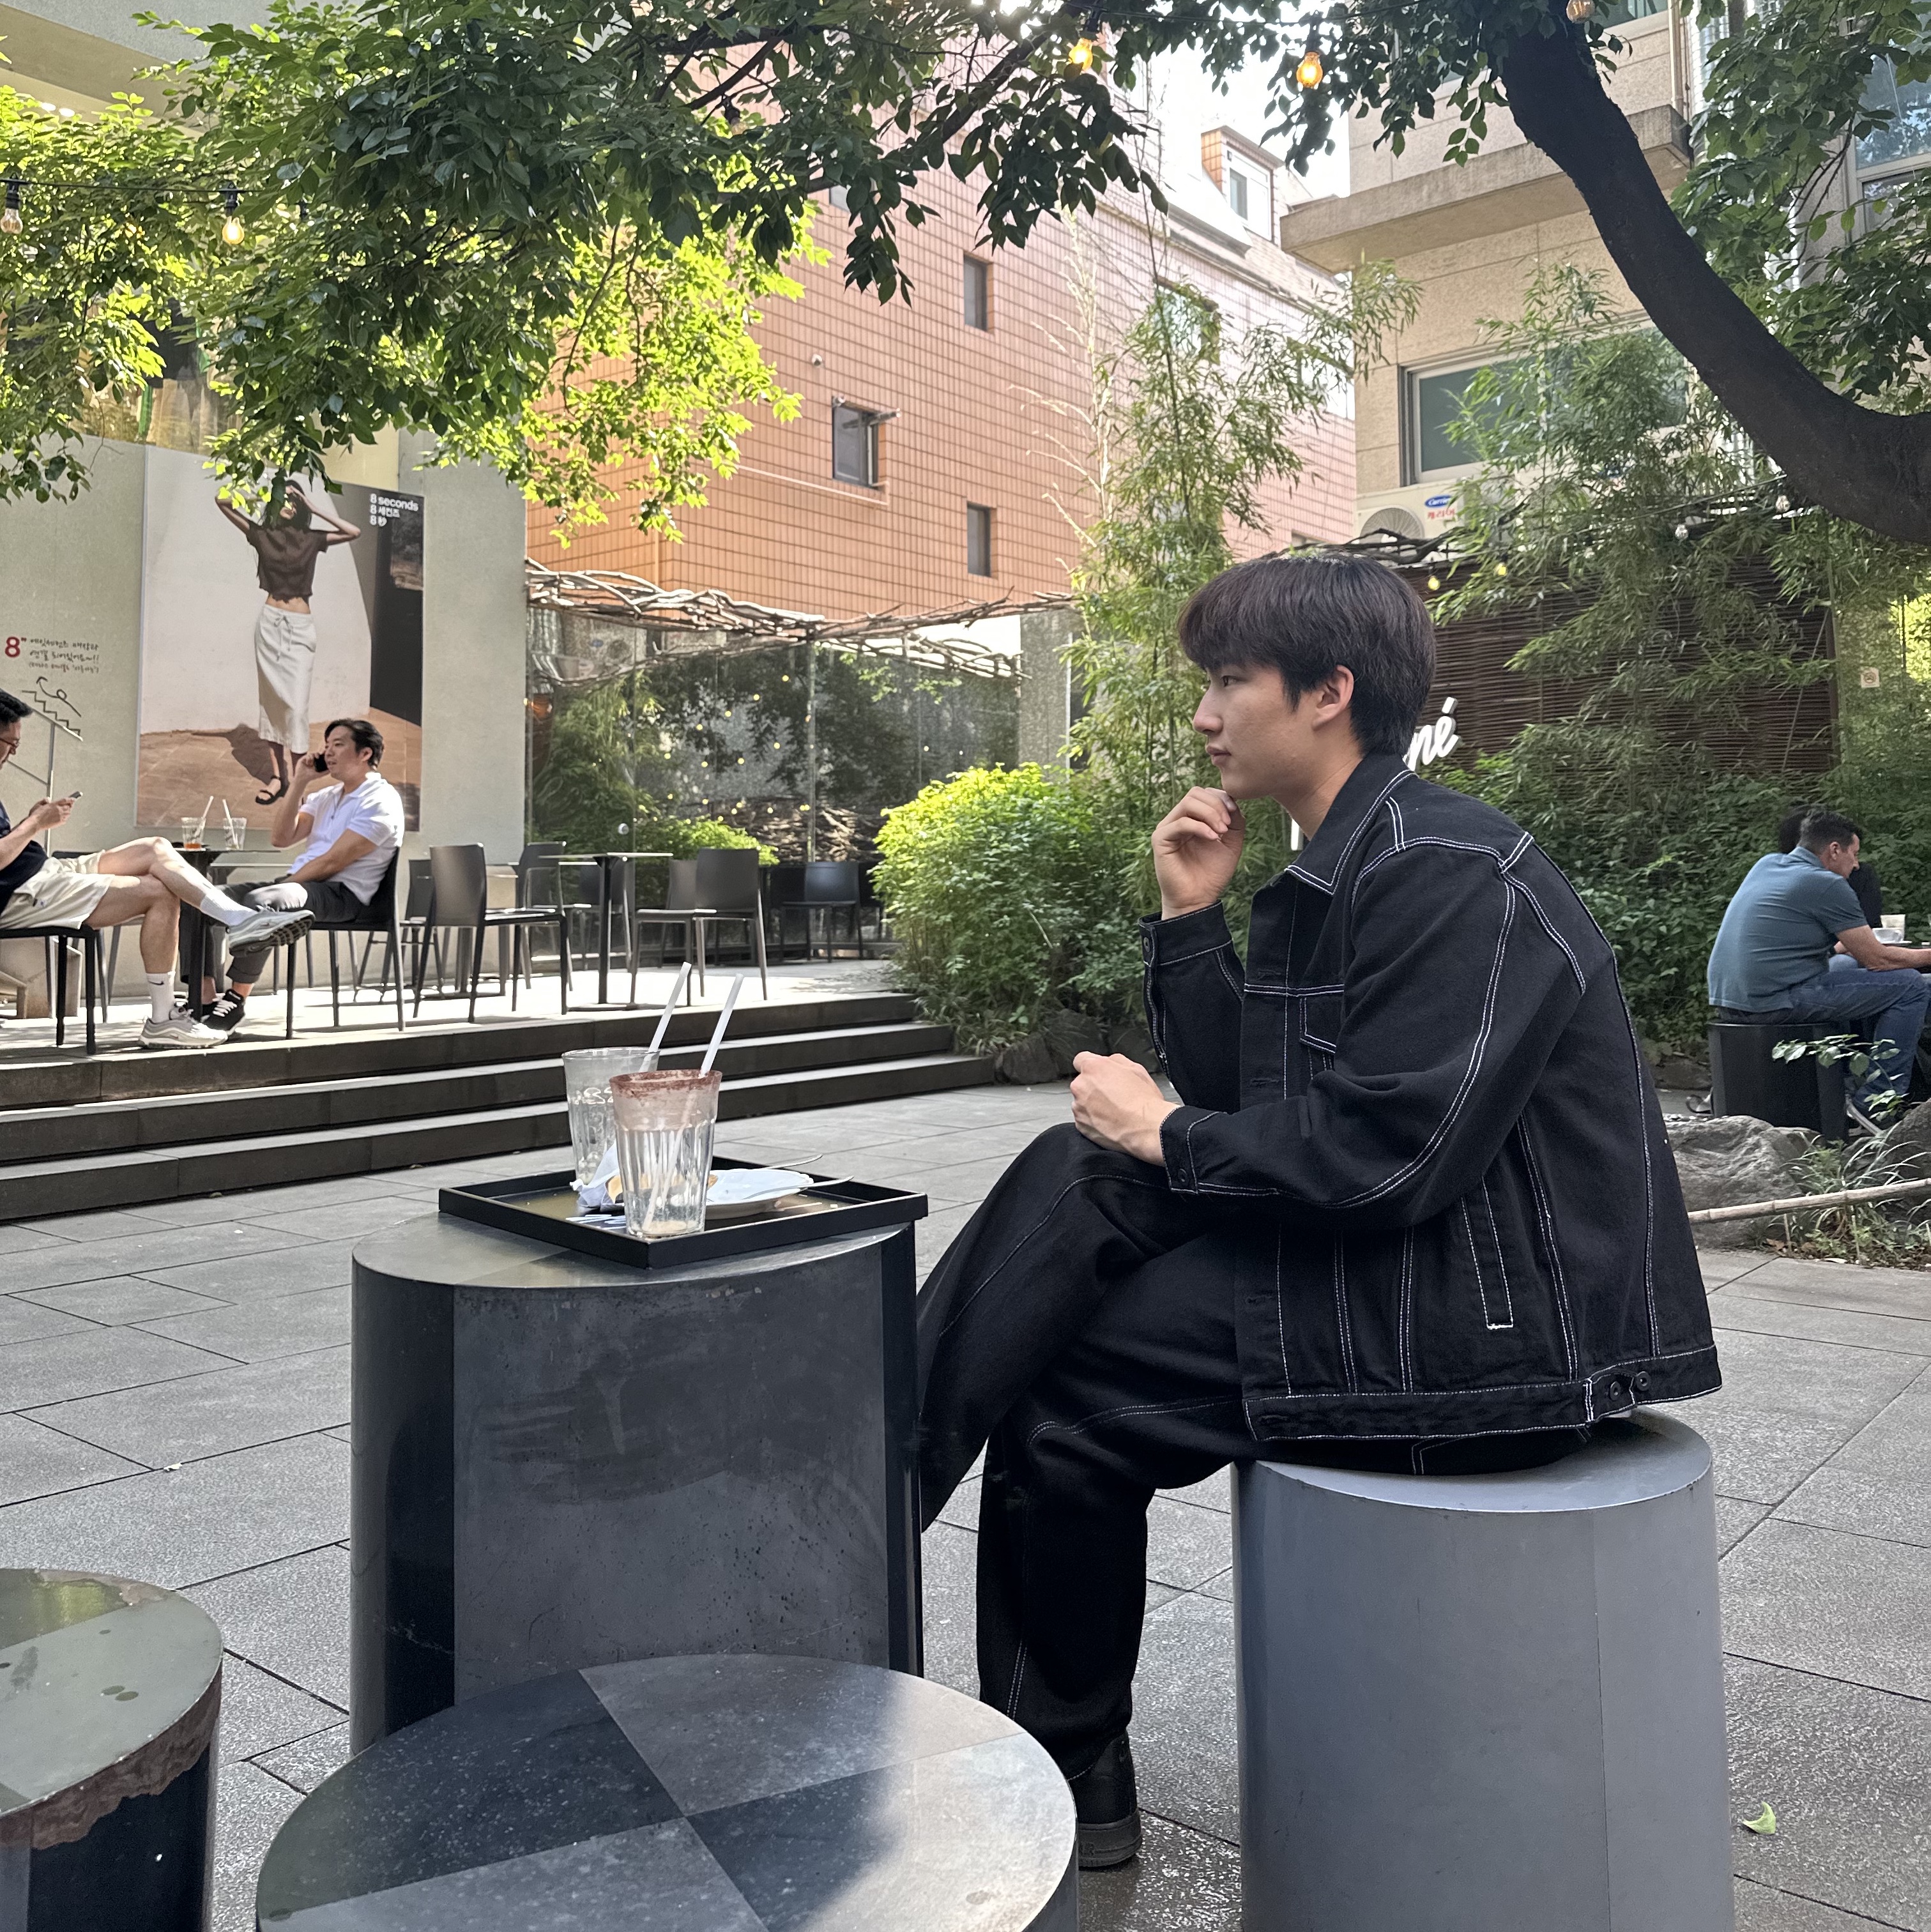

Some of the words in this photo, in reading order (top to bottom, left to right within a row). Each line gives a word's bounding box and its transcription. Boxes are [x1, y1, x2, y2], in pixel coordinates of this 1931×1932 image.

[370, 493, 377, 504] 8
[378, 496, 418, 512] seconds
[370, 504, 377, 515] 8
[370, 515, 377, 526] 8
